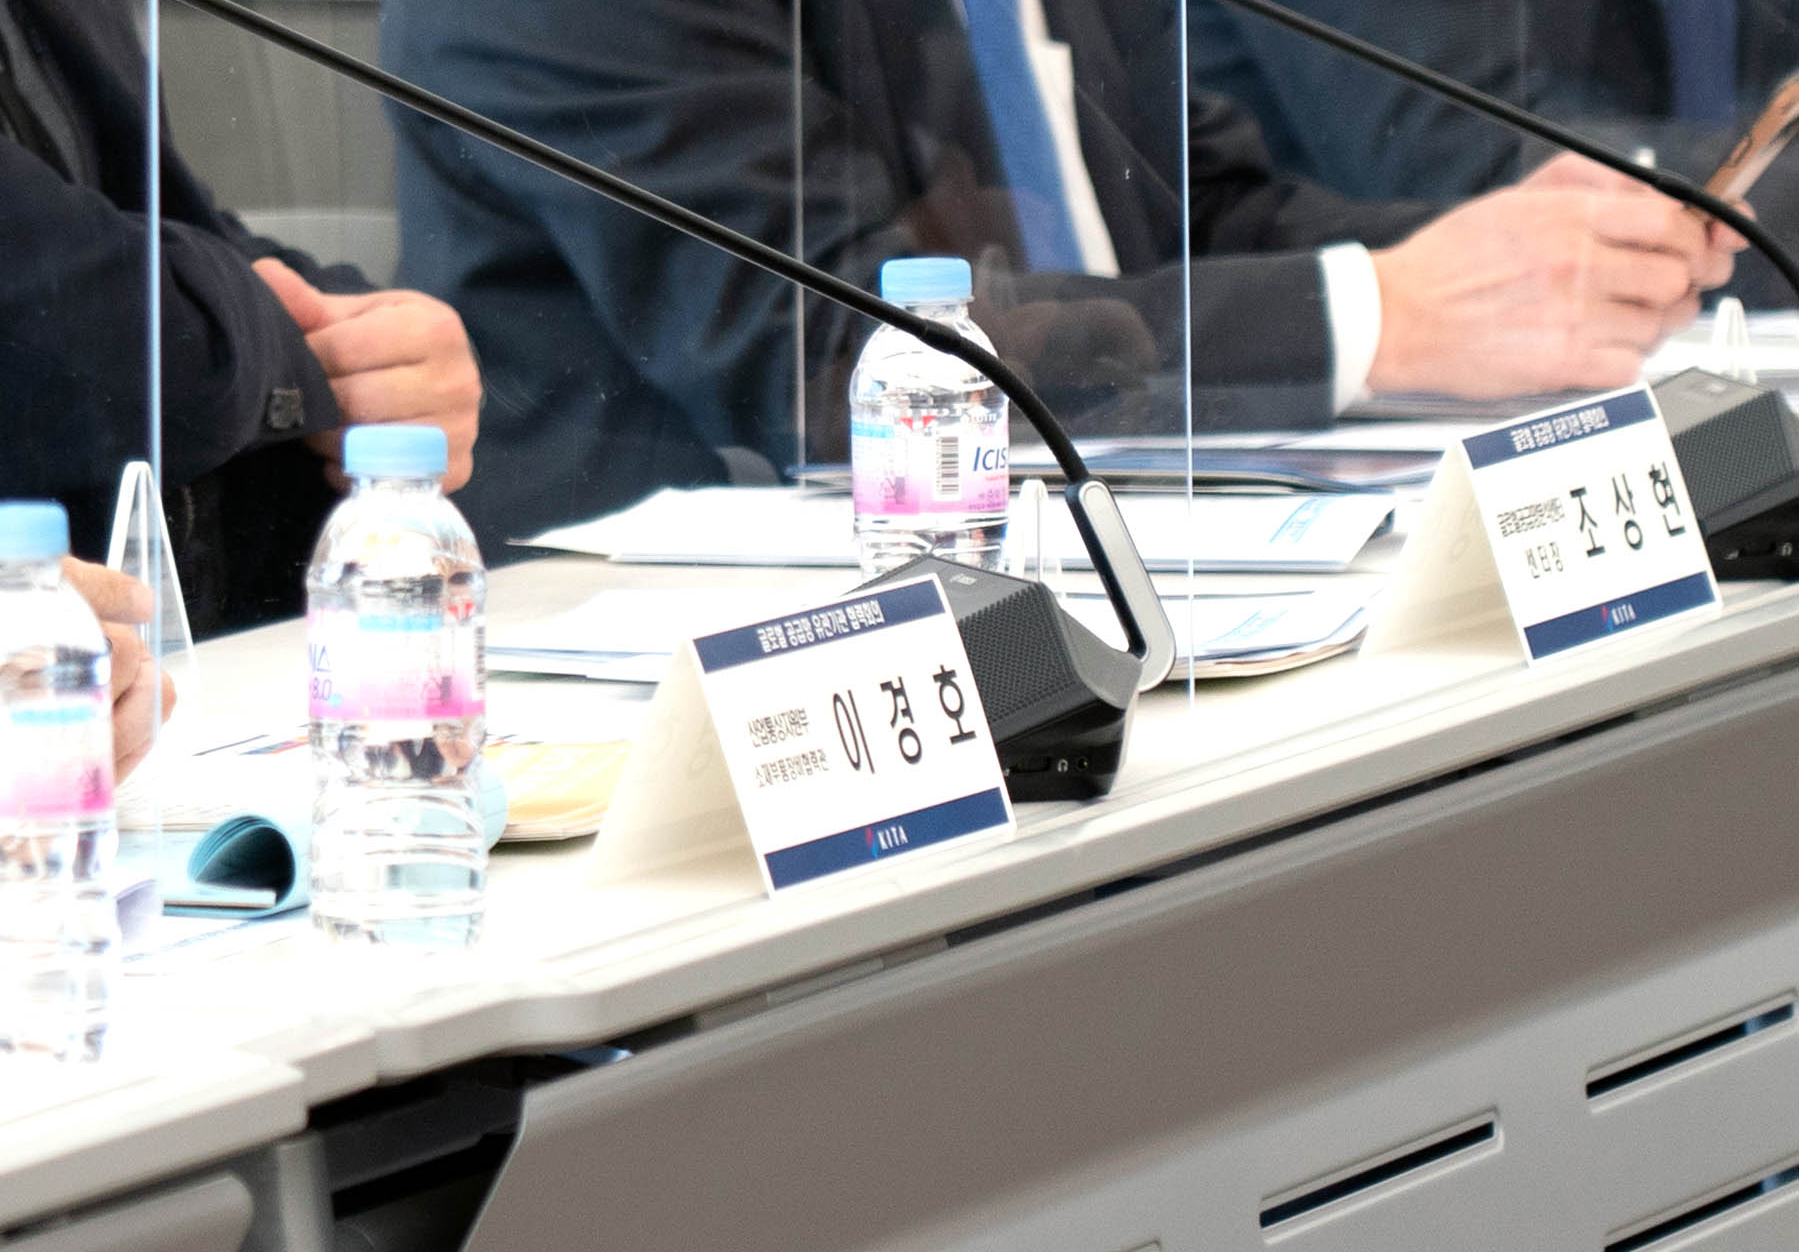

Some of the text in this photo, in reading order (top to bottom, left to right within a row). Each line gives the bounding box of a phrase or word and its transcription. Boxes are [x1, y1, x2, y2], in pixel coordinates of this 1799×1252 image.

[757, 599, 886, 653] 글로벌 공급망 유관기관 협력회의
[877, 825, 909, 850] KITA
